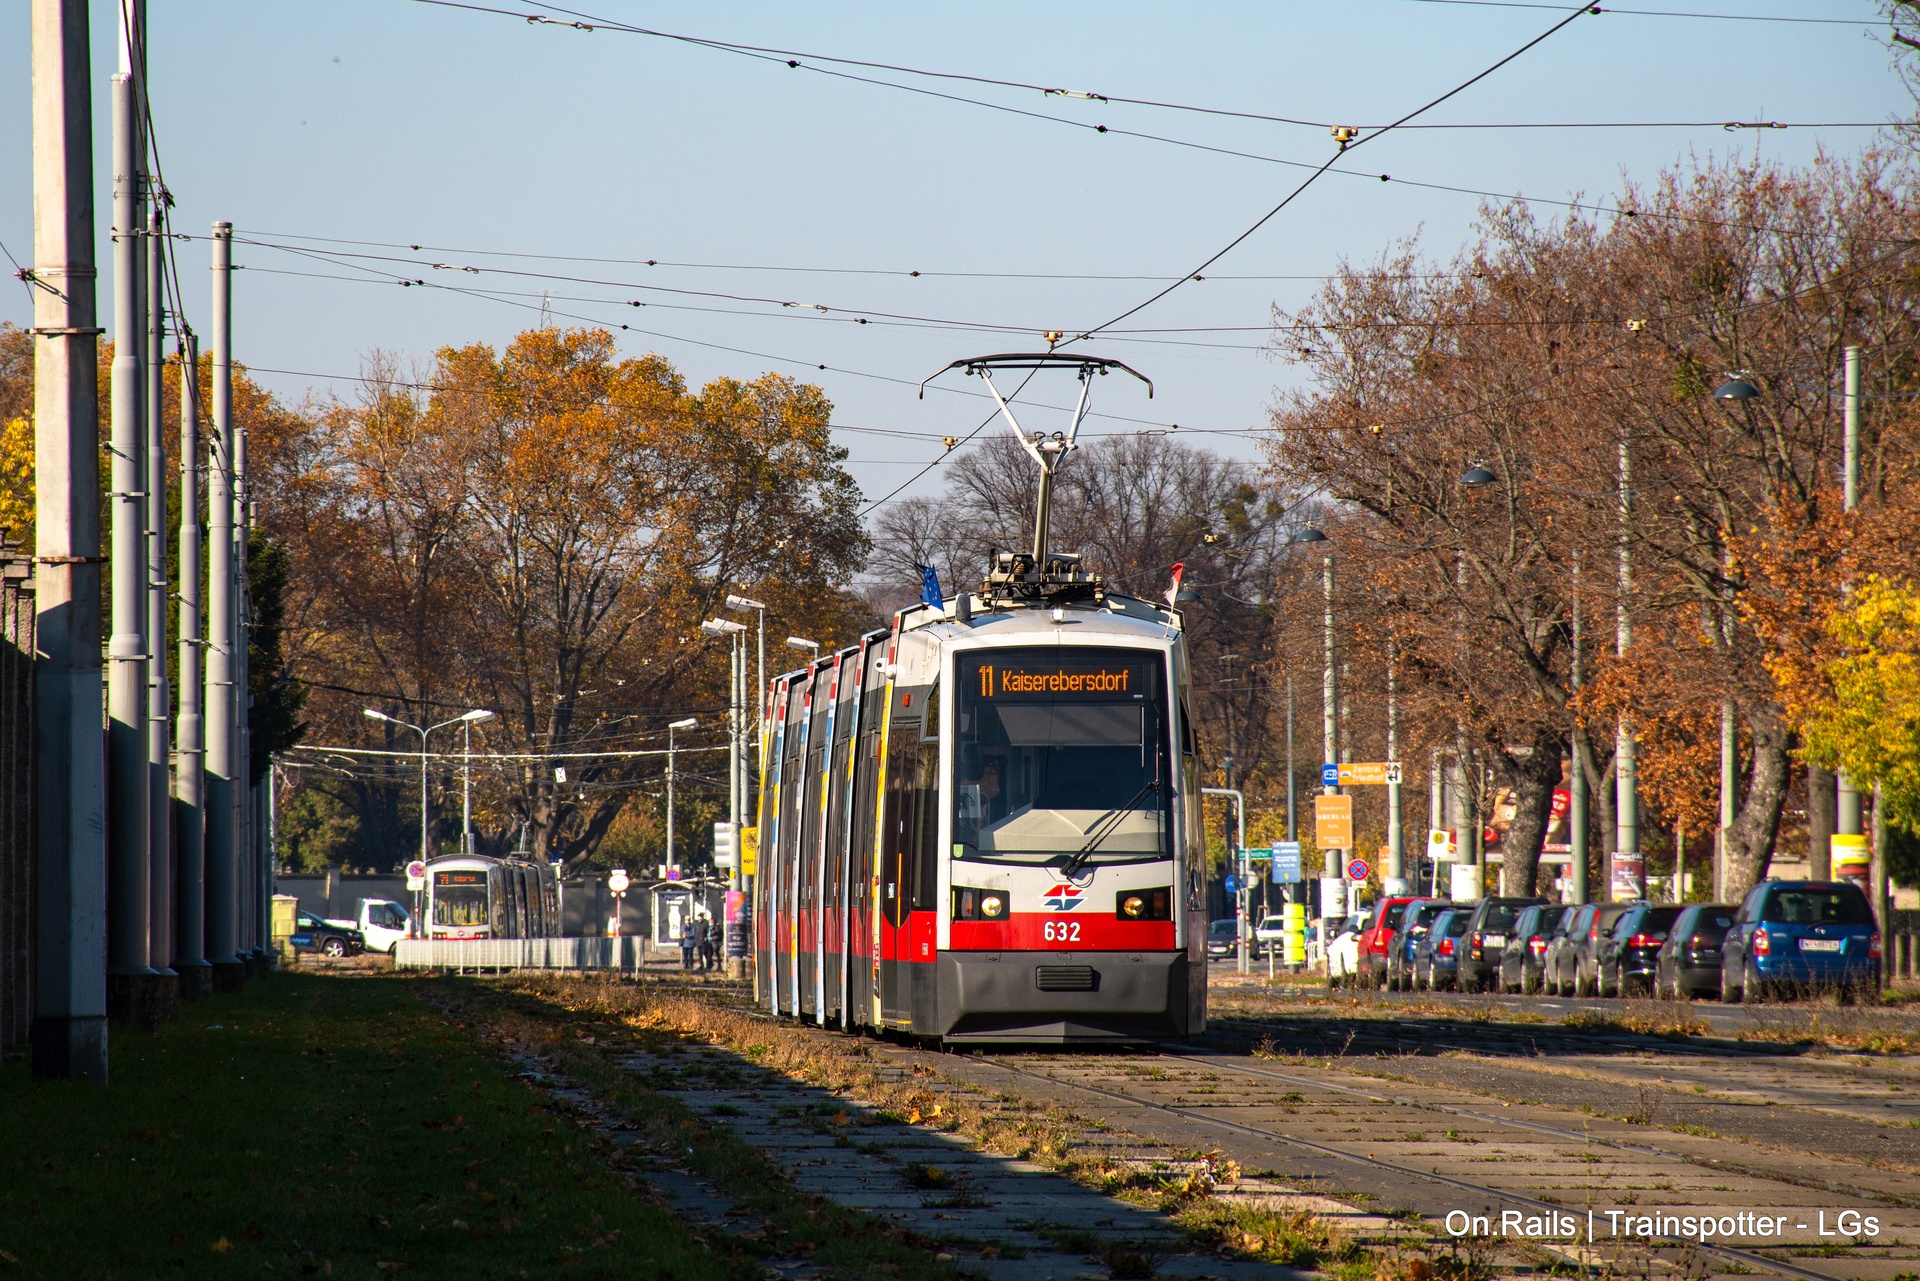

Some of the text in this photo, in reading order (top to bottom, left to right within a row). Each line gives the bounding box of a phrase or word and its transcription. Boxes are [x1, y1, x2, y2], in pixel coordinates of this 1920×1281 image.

[978, 665, 1129, 697] 11 Kaiserebersdorf
[1044, 921, 1081, 942] 632
